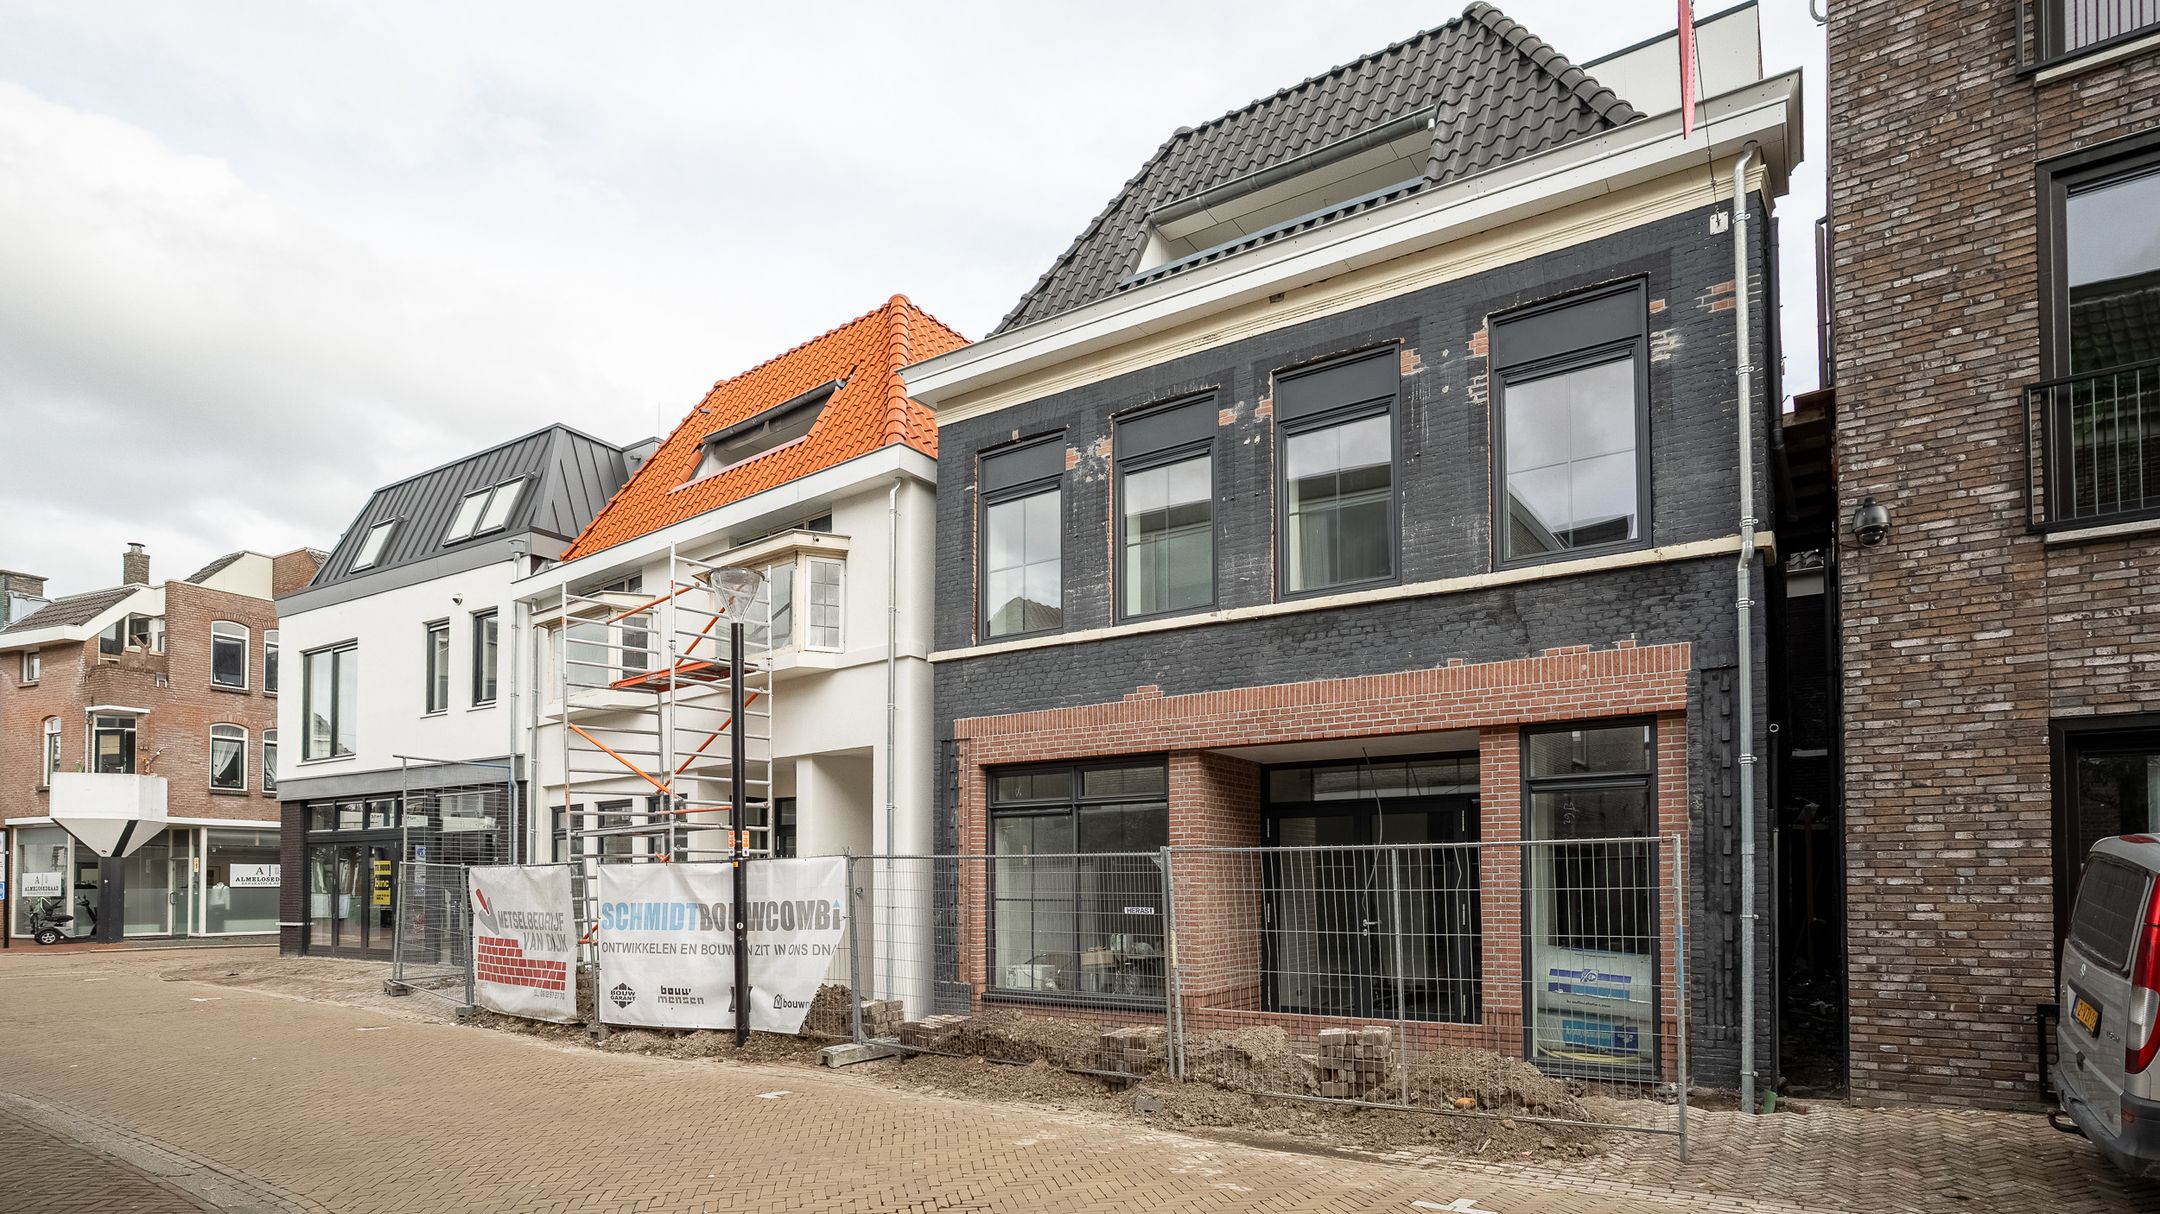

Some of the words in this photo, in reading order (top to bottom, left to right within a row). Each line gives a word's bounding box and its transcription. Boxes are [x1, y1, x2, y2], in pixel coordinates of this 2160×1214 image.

[497, 911, 564, 931] METSELBEDRIJF
[523, 932, 544, 951] VAN
[545, 933, 569, 953] DIJK
[601, 942, 677, 954] ONTWIKKELEN
[680, 944, 698, 955] EN
[700, 944, 753, 955] BOUWN
[754, 944, 771, 956] ZIT
[774, 944, 787, 956] IN
[788, 944, 809, 956] ONS
[660, 985, 692, 995] bouw
[658, 996, 704, 1005] mensen
